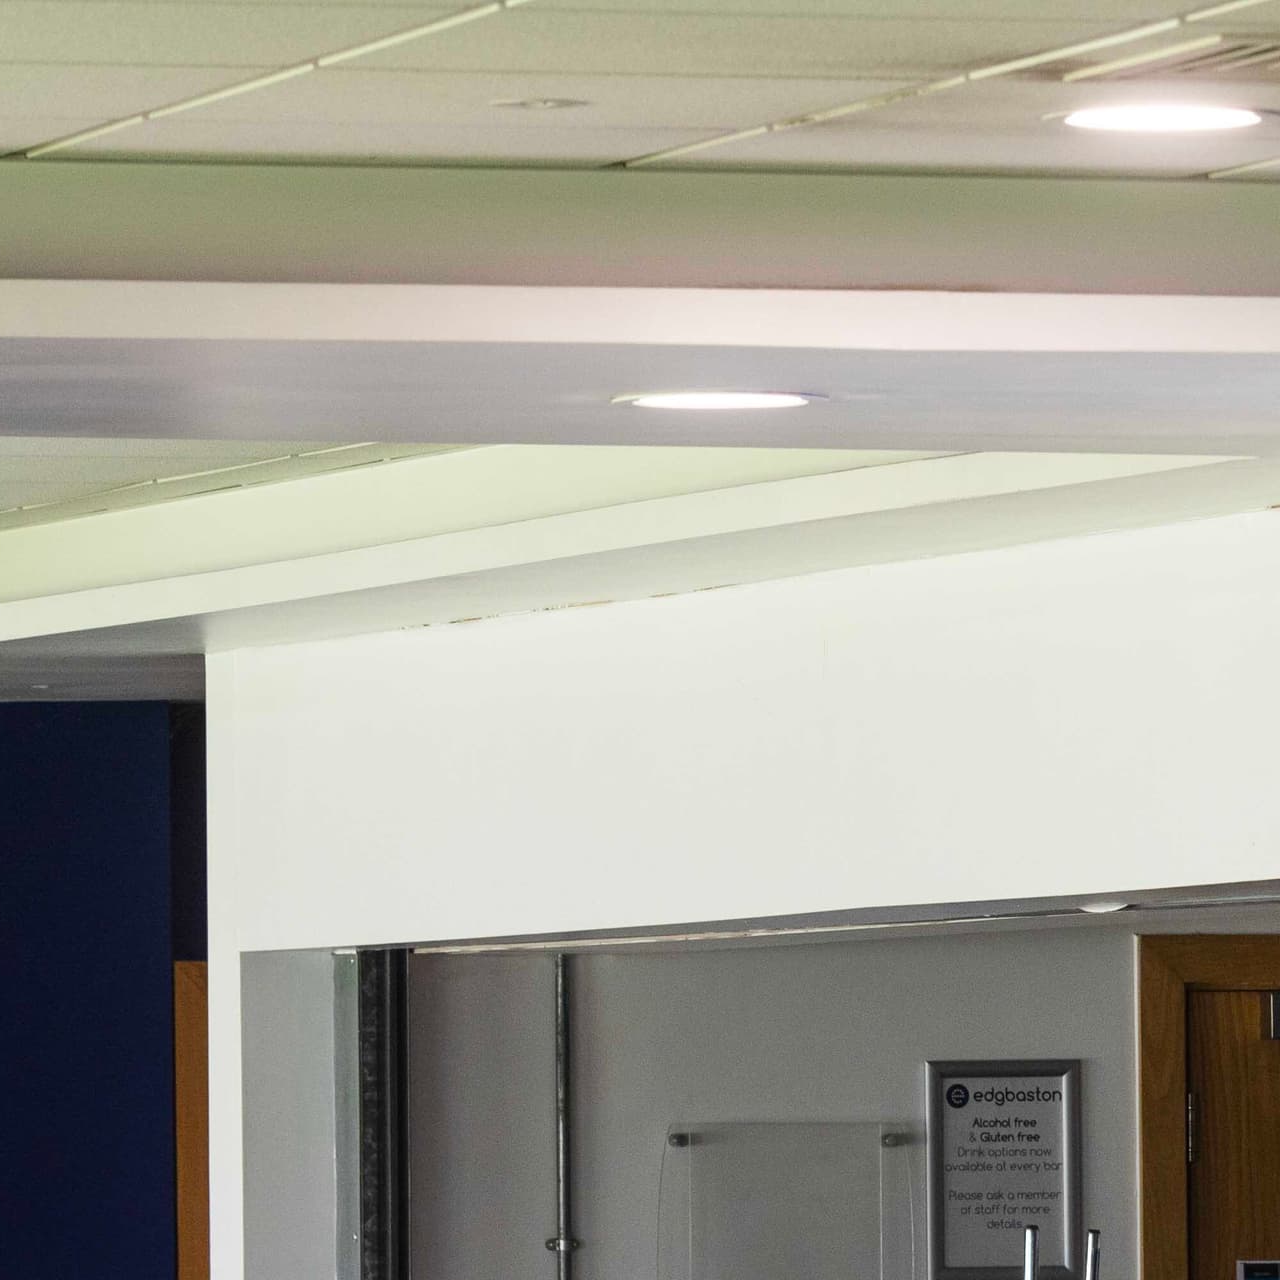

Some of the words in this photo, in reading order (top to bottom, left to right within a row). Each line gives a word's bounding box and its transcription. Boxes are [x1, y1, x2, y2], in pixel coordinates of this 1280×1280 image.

[973, 1086, 1062, 1106] edgbaston
[972, 1117, 1010, 1128] Alcohol
[1014, 1117, 1037, 1128] free
[980, 1132, 1014, 1142] Gluten
[1017, 1132, 1040, 1142] free
[957, 1146, 985, 1158] Drink
[988, 1147, 1027, 1160] options
[1029, 1148, 1052, 1157] now
[944, 1162, 993, 1172] available
[1010, 1163, 1039, 1173] every
[1043, 1161, 1062, 1171] bar
[948, 1190, 983, 1201] Please
[986, 1190, 1003, 1200] ask
[1017, 1190, 1062, 1200] member
[974, 1204, 1000, 1215] staff
[1002, 1204, 1019, 1214] for
[1021, 1206, 1051, 1214] more
